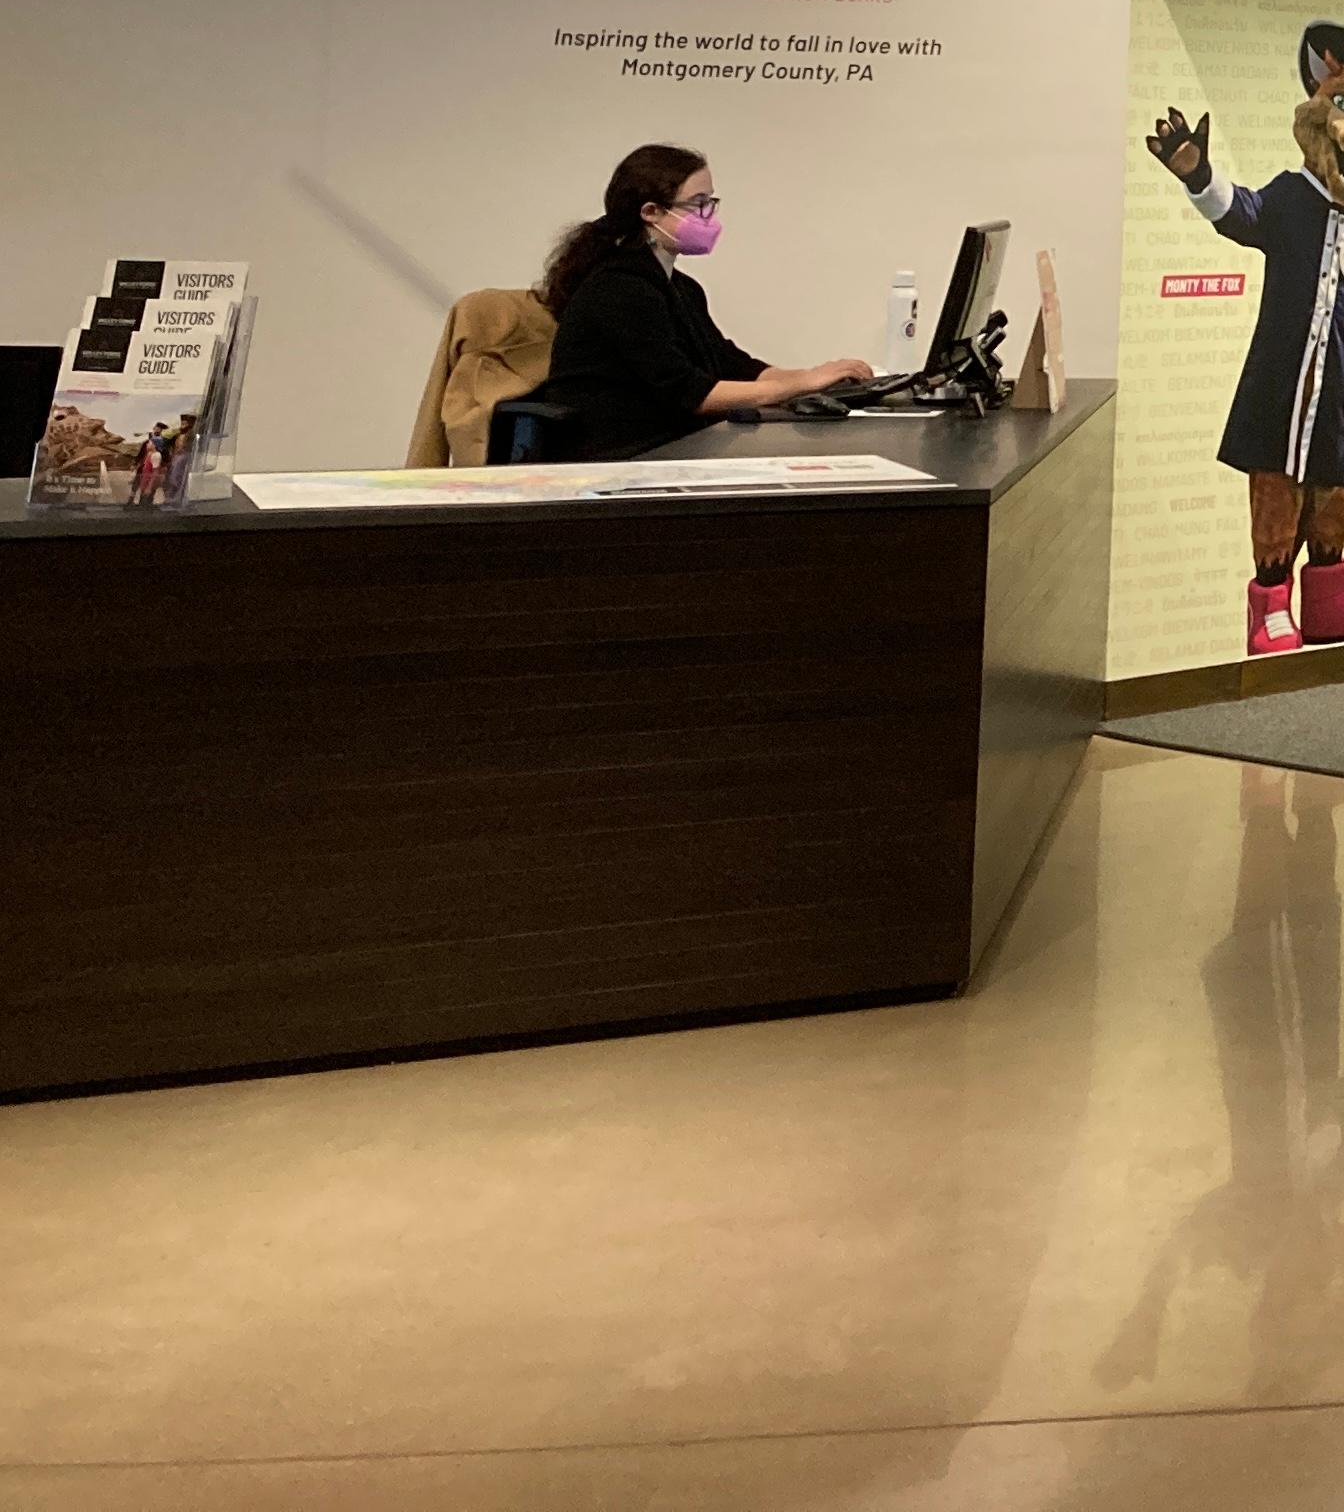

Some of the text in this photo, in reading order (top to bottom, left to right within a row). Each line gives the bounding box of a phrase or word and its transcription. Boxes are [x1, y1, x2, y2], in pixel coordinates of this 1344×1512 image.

[554, 28, 942, 56] Inspiring the world to fall in love with
[622, 59, 874, 84] Montgomery County, PA
[177, 274, 234, 287] VISITORS
[1166, 278, 1241, 293] MONTY THE FOX
[174, 289, 211, 300] GUIDE
[157, 311, 215, 325] VISITORS
[143, 344, 201, 358] VISITORS
[139, 361, 176, 374] GUIDE
[1170, 495, 1216, 512] WELCOME
